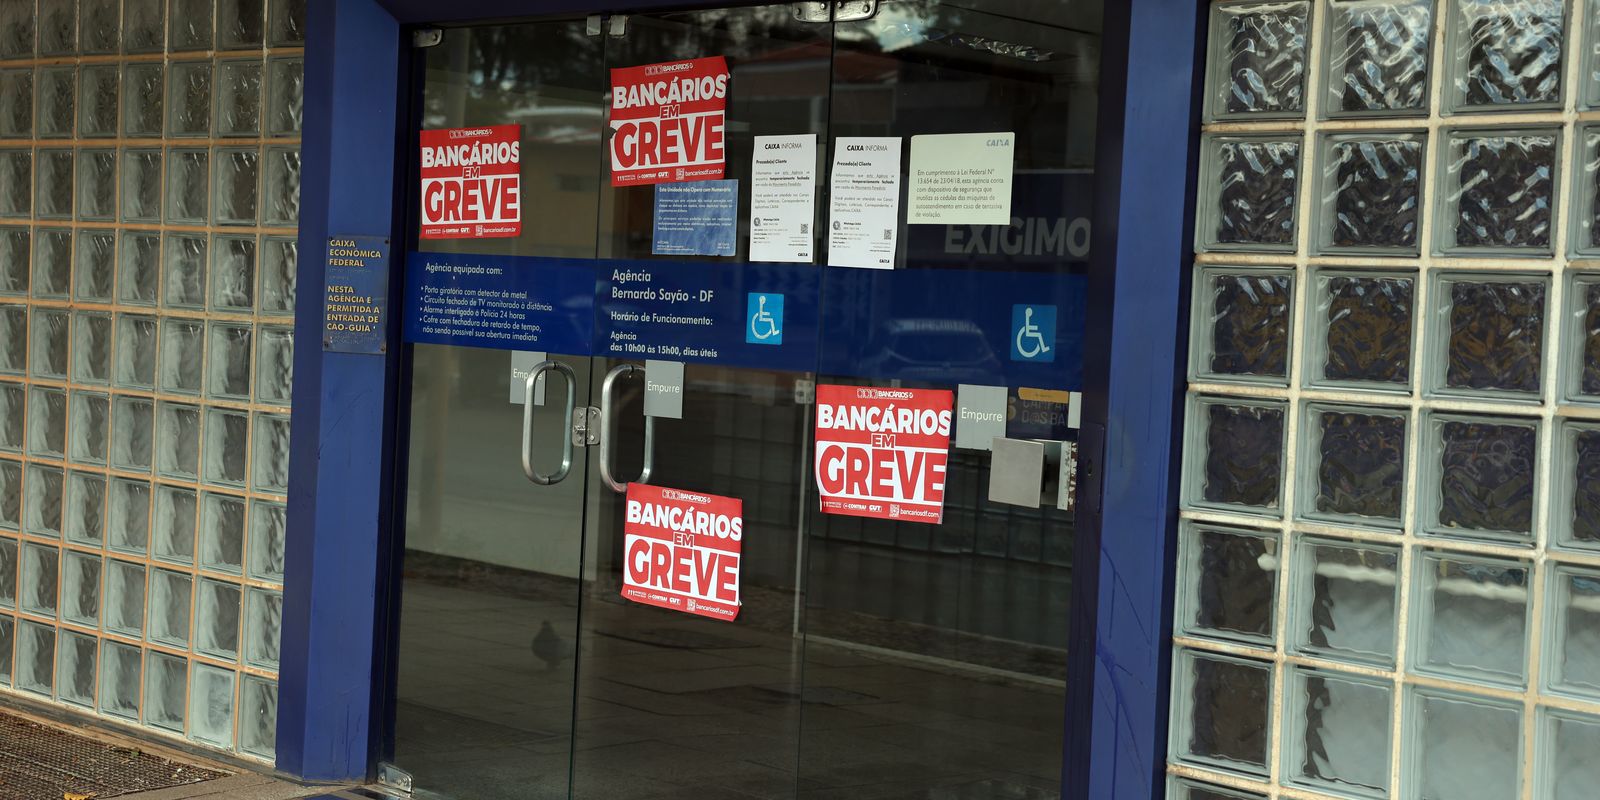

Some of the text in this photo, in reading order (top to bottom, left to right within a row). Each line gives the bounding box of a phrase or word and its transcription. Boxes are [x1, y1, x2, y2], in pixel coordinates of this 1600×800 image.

[613, 74, 727, 109] BANCÁRIOS
[660, 104, 680, 119] EM
[614, 114, 723, 168] GREVE
[422, 141, 519, 168] BANCÁRIOS
[463, 166, 480, 178] EM
[425, 178, 518, 222] GREVE
[330, 240, 355, 248] CAIXA
[426, 262, 451, 273] Agência
[453, 265, 484, 275] equipada
[612, 269, 651, 284] Agência
[327, 285, 354, 293] NESTA
[425, 285, 438, 294] Porta
[440, 286, 463, 295] giratória
[477, 288, 500, 297] detector
[612, 286, 656, 300] Bernardo
[659, 288, 688, 304] Sayão
[700, 290, 713, 302] DF
[327, 305, 371, 313] PERMITIDA
[424, 295, 445, 304] Circuito
[447, 296, 468, 305] fechado
[487, 300, 520, 309] monitorado
[327, 314, 365, 322] ENTRADA
[424, 305, 443, 314] Alarme
[444, 306, 474, 316] interligado
[509, 311, 525, 320] horas
[611, 311, 713, 325] Horário de Funcionamento:
[423, 315, 438, 323] Cofre
[453, 317, 480, 326] fechadura
[490, 321, 511, 329] retardo
[521, 323, 542, 332] tempo,
[434, 327, 451, 335] sendo
[486, 330, 511, 339] abertura
[512, 332, 537, 341] imediata
[611, 331, 637, 341] Agência
[610, 343, 718, 358] das 10h00 às 15h00, dias úteis
[513, 368, 542, 381] Empe
[647, 381, 680, 394] Empurre
[818, 404, 952, 436] BANCÁRIOS
[961, 407, 1002, 422] Empurre
[871, 433, 895, 448] EM
[820, 444, 948, 502] GREVE
[627, 500, 742, 542] BANCÁRIOS
[673, 532, 694, 547] EM
[628, 539, 738, 602] GREVE
